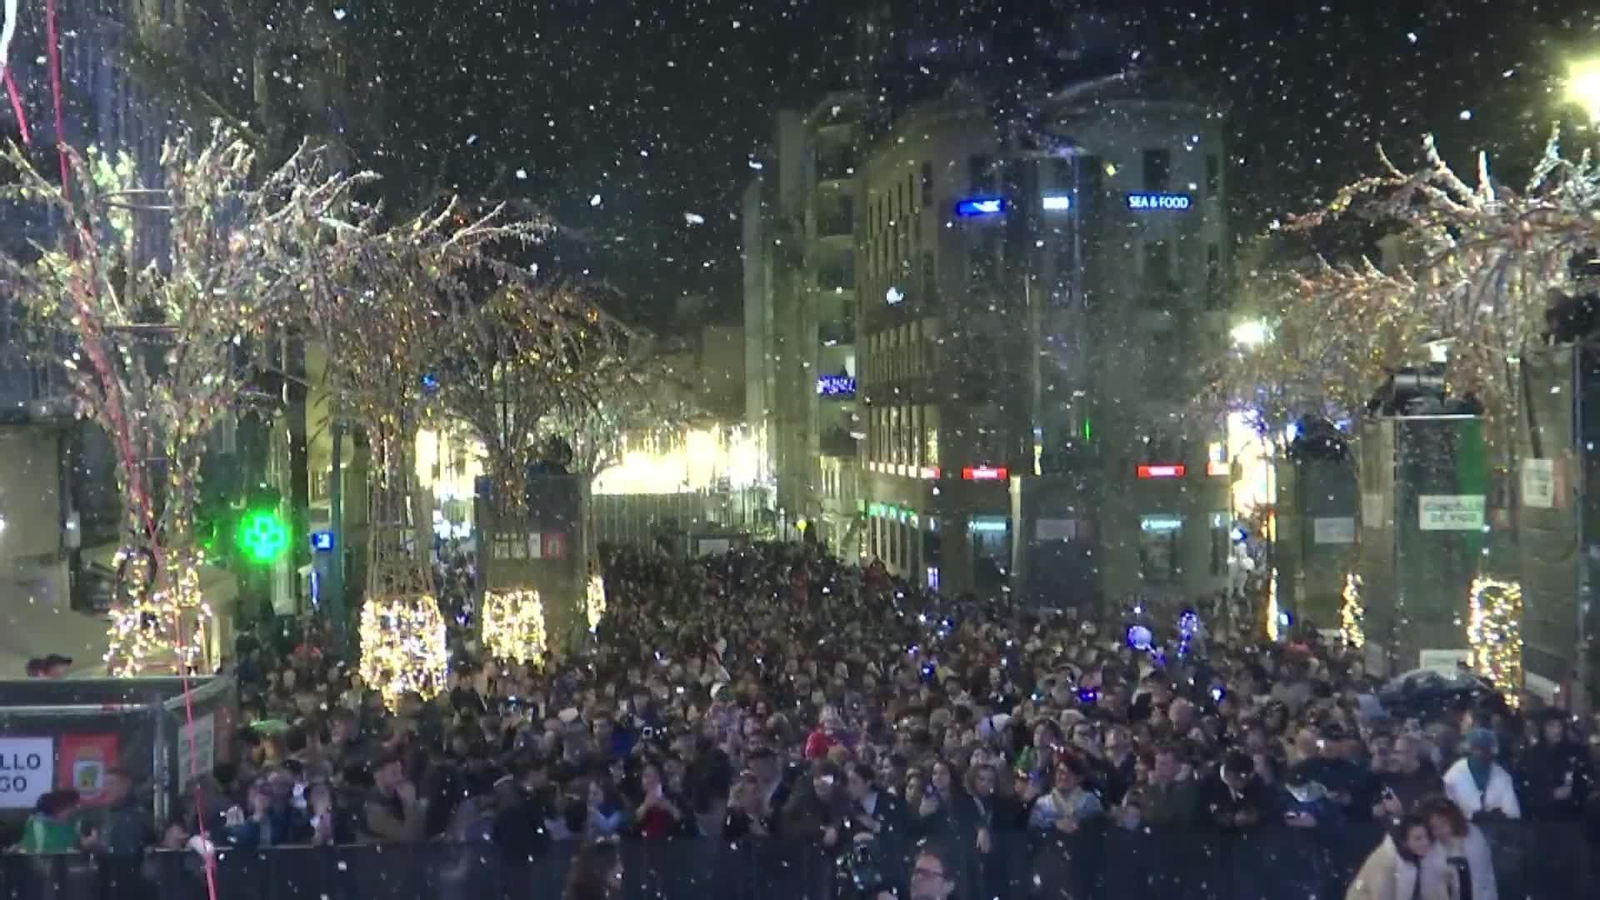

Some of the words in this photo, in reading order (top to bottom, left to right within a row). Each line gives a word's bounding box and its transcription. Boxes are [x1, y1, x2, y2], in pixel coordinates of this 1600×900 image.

[1128, 195, 1149, 208] SEA
[1150, 195, 1158, 208] &
[1159, 196, 1189, 209] FOOD
[0, 753, 41, 770] LLO
